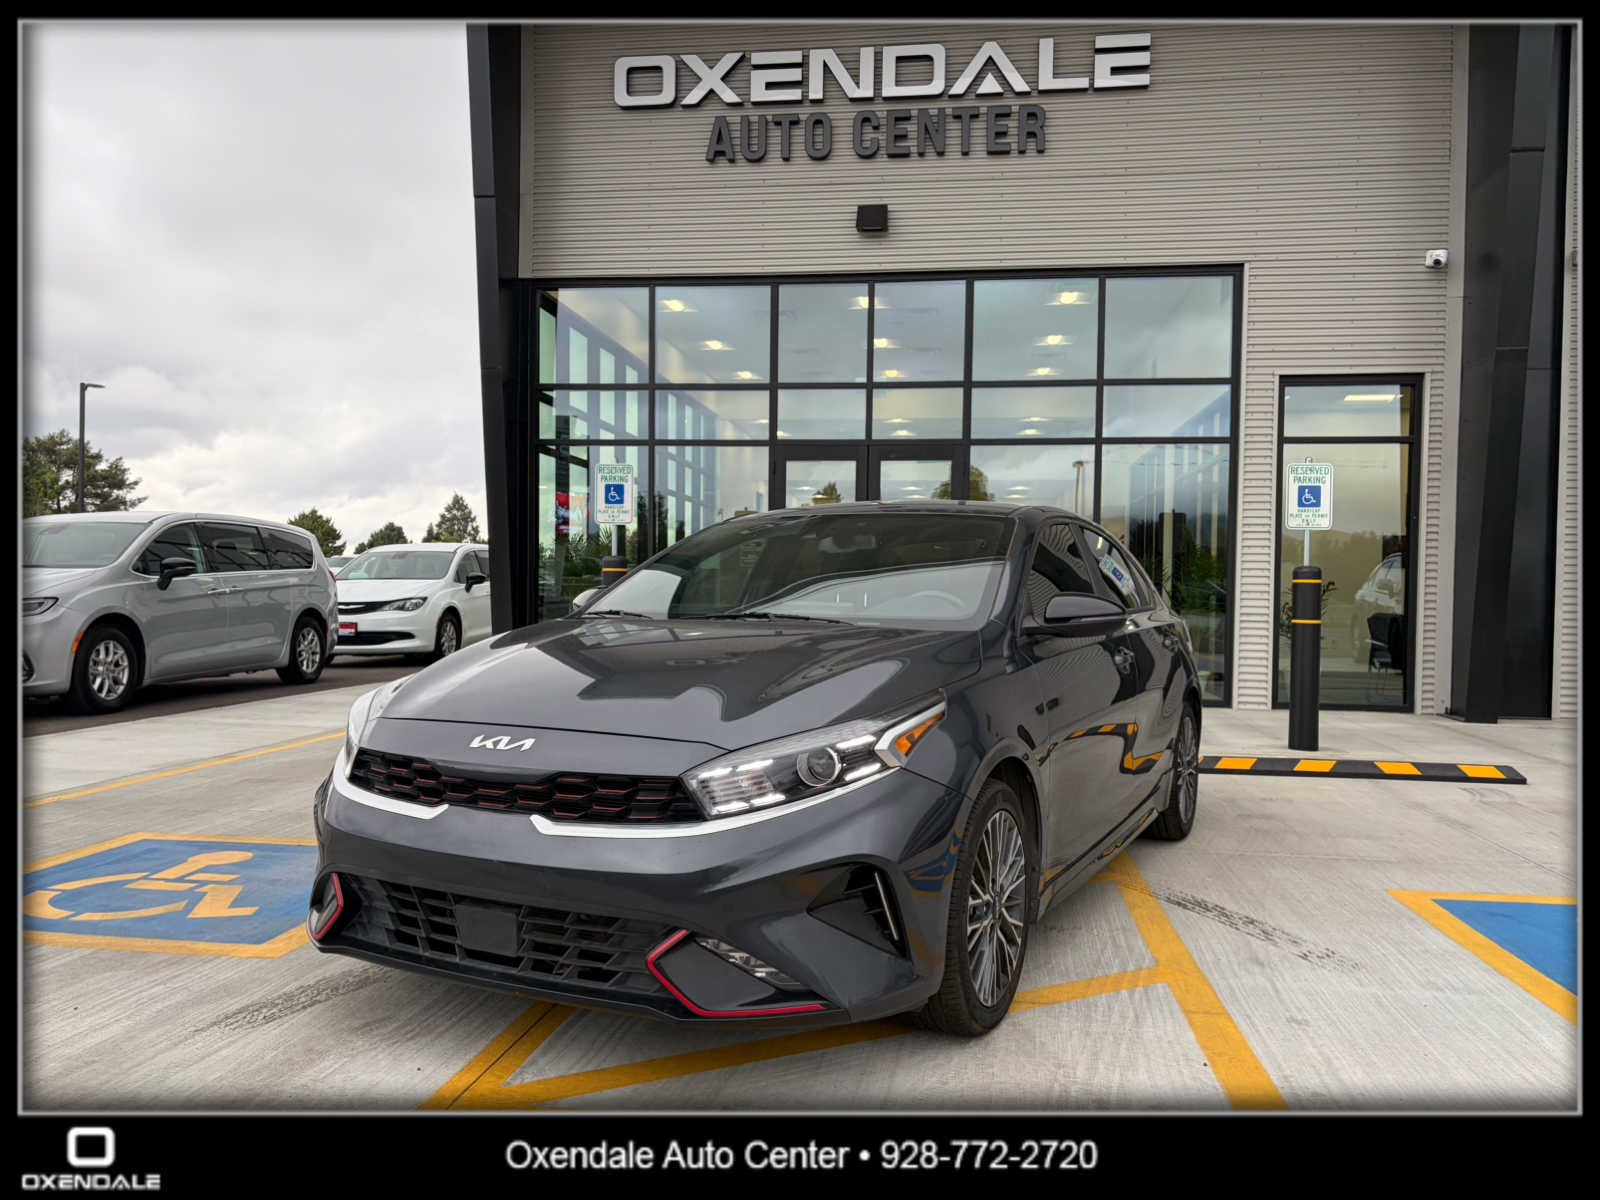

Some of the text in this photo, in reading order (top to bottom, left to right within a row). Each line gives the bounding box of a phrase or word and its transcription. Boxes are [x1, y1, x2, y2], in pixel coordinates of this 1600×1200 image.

[614, 33, 1151, 108] OXENDALE
[706, 103, 1046, 162] AUTO CENTER
[598, 466, 631, 475] RESERVED
[1290, 466, 1329, 475] RESERVED
[601, 475, 629, 483] PARKING
[1293, 475, 1326, 484] PARKING
[469, 734, 536, 752] KIA
